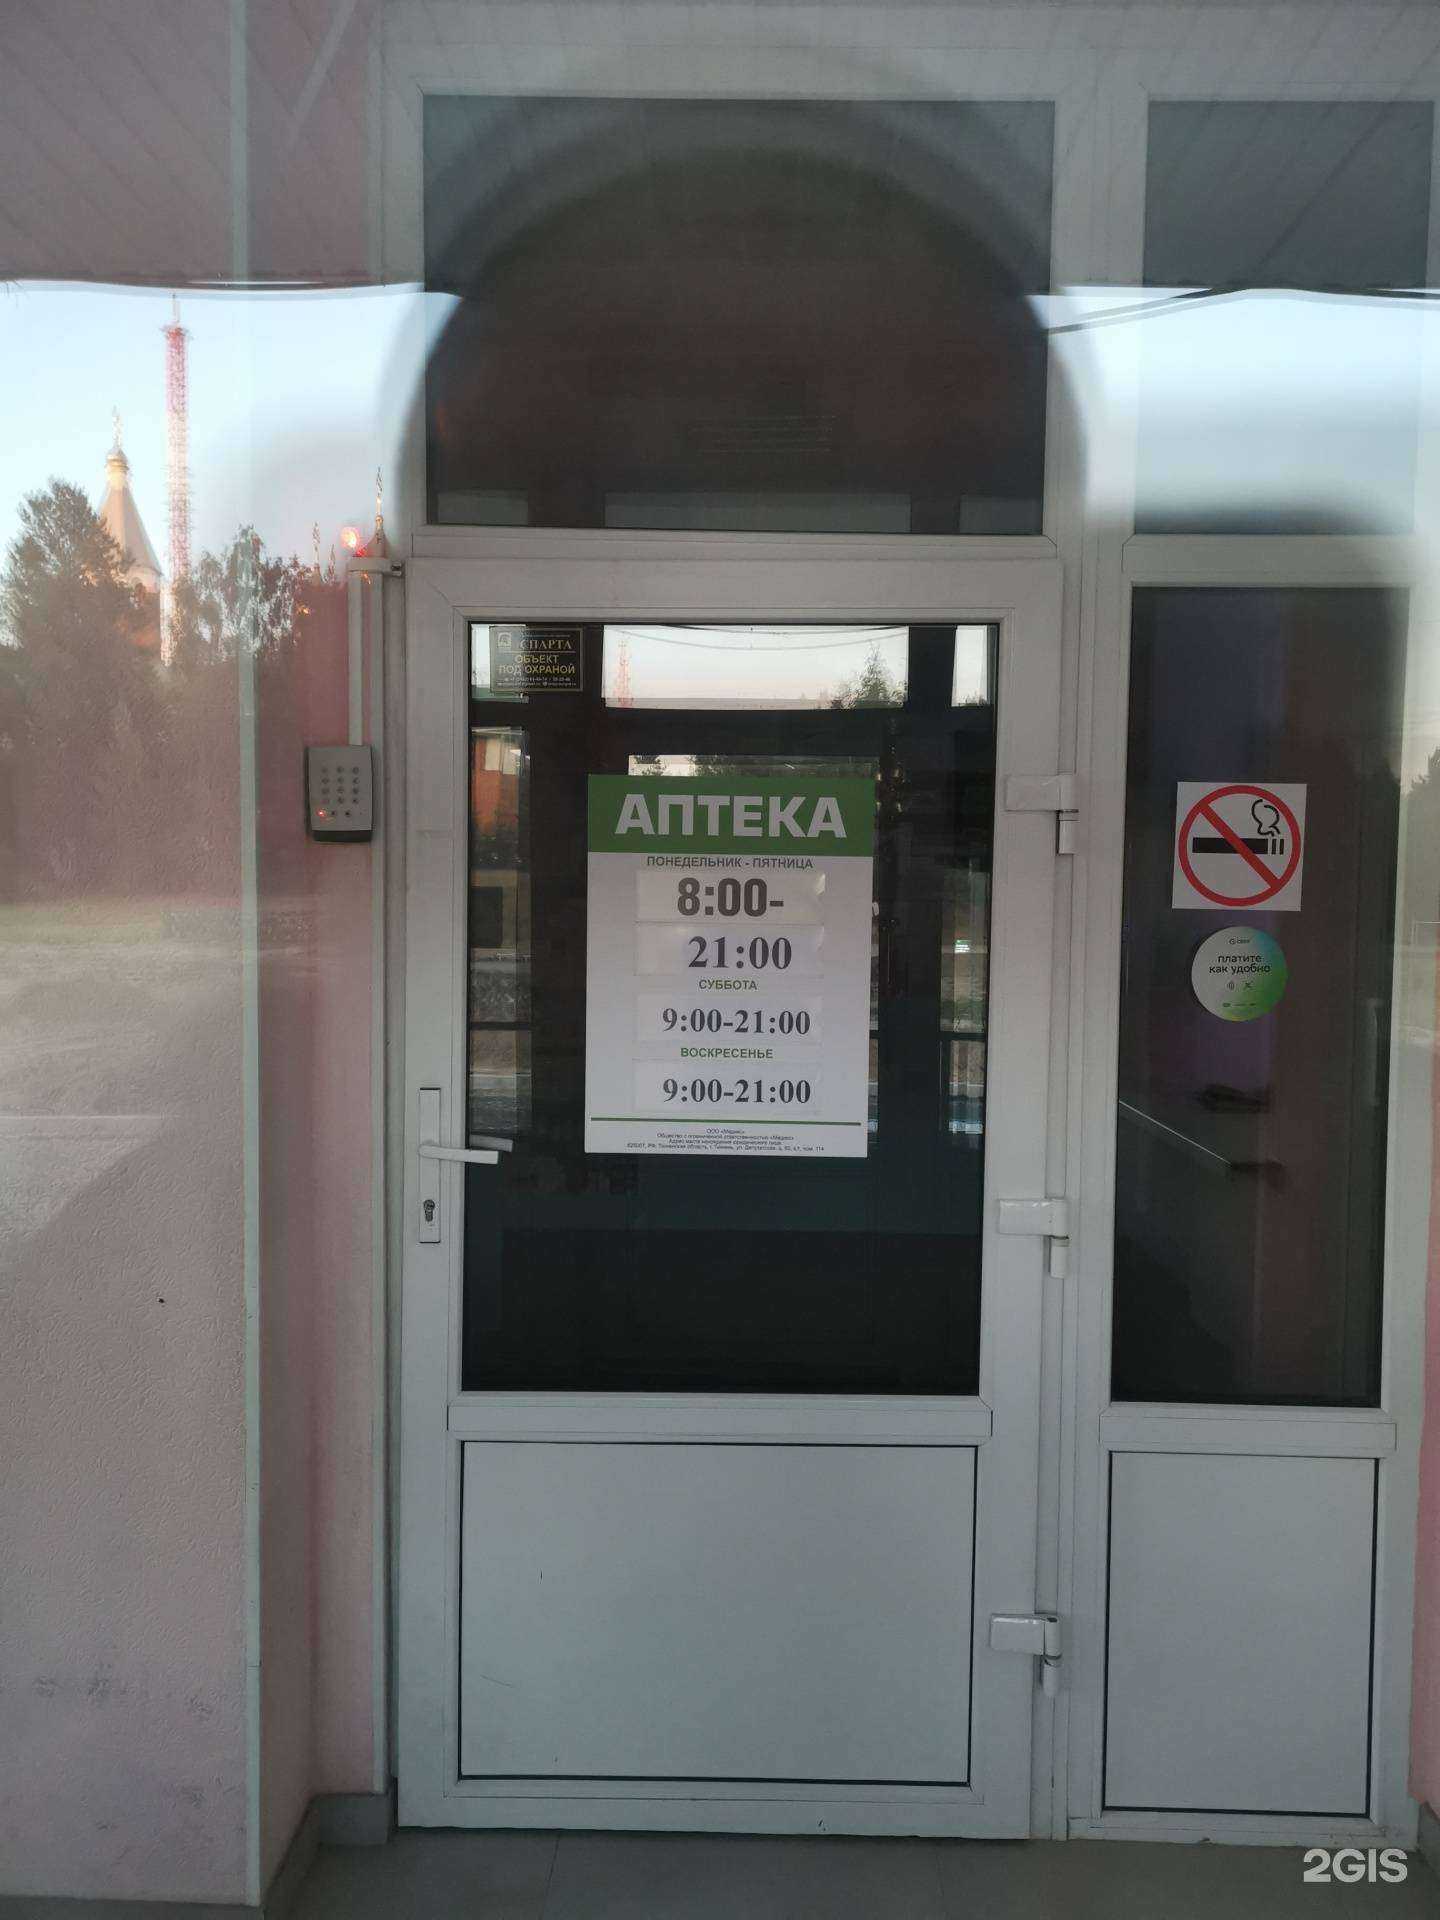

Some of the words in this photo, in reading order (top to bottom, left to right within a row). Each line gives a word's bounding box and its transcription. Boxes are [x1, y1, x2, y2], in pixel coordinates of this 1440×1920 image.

[514, 654, 560, 664] ОБЪЕКТ
[498, 664, 522, 676] ПОД
[524, 663, 576, 675] ОХРАНОЙ
[614, 793, 848, 839] АПТЕКА
[646, 855, 742, 869] ПОНЕДЕЛЬНИК
[752, 857, 814, 870] ПЯТНИЦА
[677, 877, 784, 917] 8:00-
[688, 935, 792, 970] 21:00
[1217, 954, 1262, 964] платите
[1209, 965, 1228, 974] как
[1231, 962, 1271, 975] удобно
[699, 979, 758, 991] СУББОТА
[662, 1008, 811, 1035] 9:00-21:00
[680, 1046, 774, 1060] ВОСКРЕСЕНЬЕ
[662, 1078, 812, 1104] 9:00-21:00
